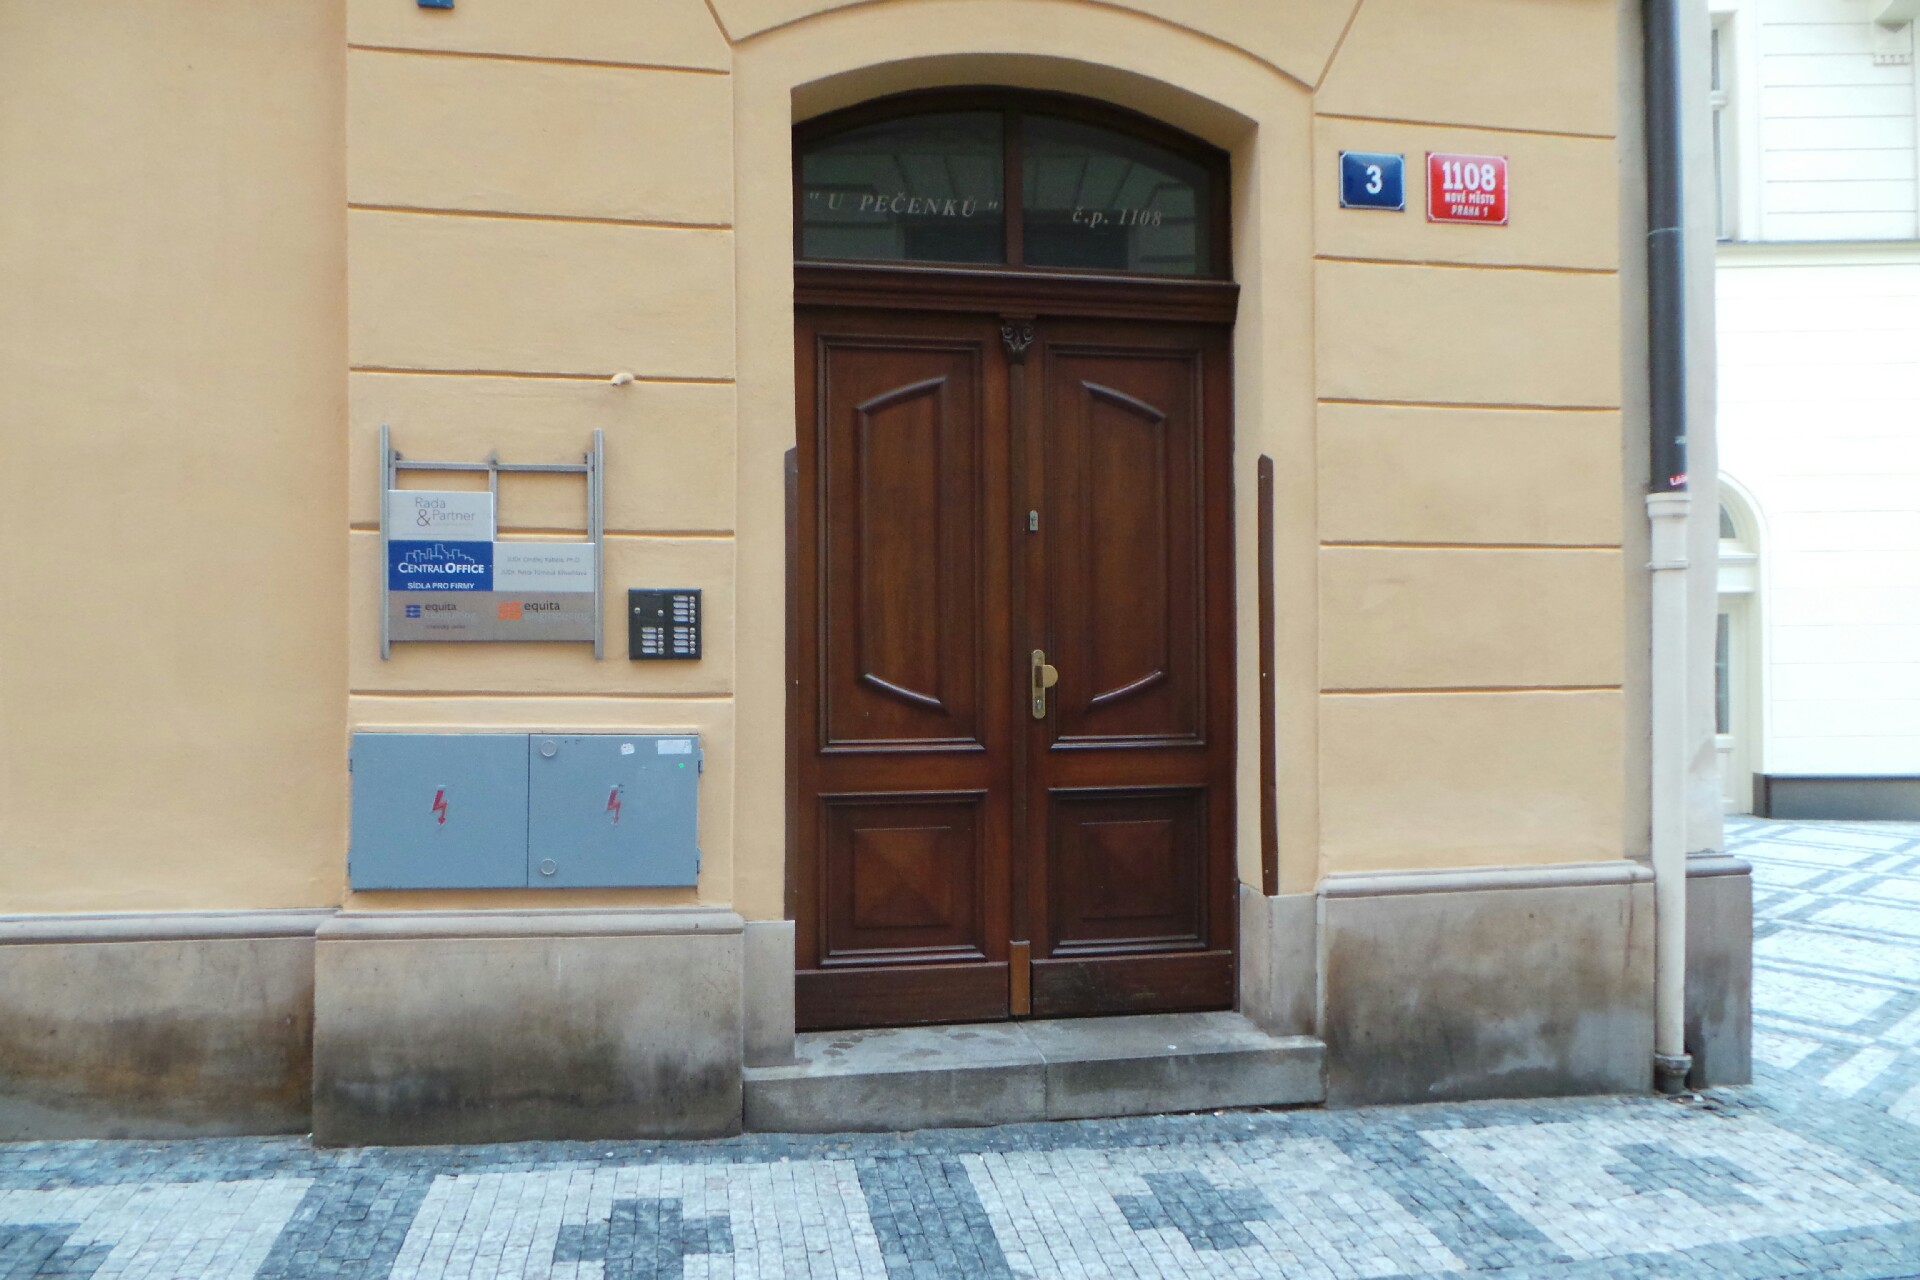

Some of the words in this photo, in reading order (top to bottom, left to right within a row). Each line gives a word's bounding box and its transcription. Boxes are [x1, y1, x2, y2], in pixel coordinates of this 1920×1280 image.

[1365, 164, 1383, 195] 3
[1442, 161, 1496, 191] 1108
[1444, 191, 1466, 203] NOVÉ
[1469, 191, 1496, 205] MĚSTO
[1120, 208, 1161, 227] 1108
[1451, 205, 1479, 216] PRAHA
[1482, 207, 1489, 217] 1
[415, 497, 446, 508] Rada
[416, 509, 431, 526] &
[432, 510, 475, 521] Partner
[407, 581, 431, 589] SÍDLA
[424, 601, 457, 613] equita
[523, 600, 561, 613] equita
